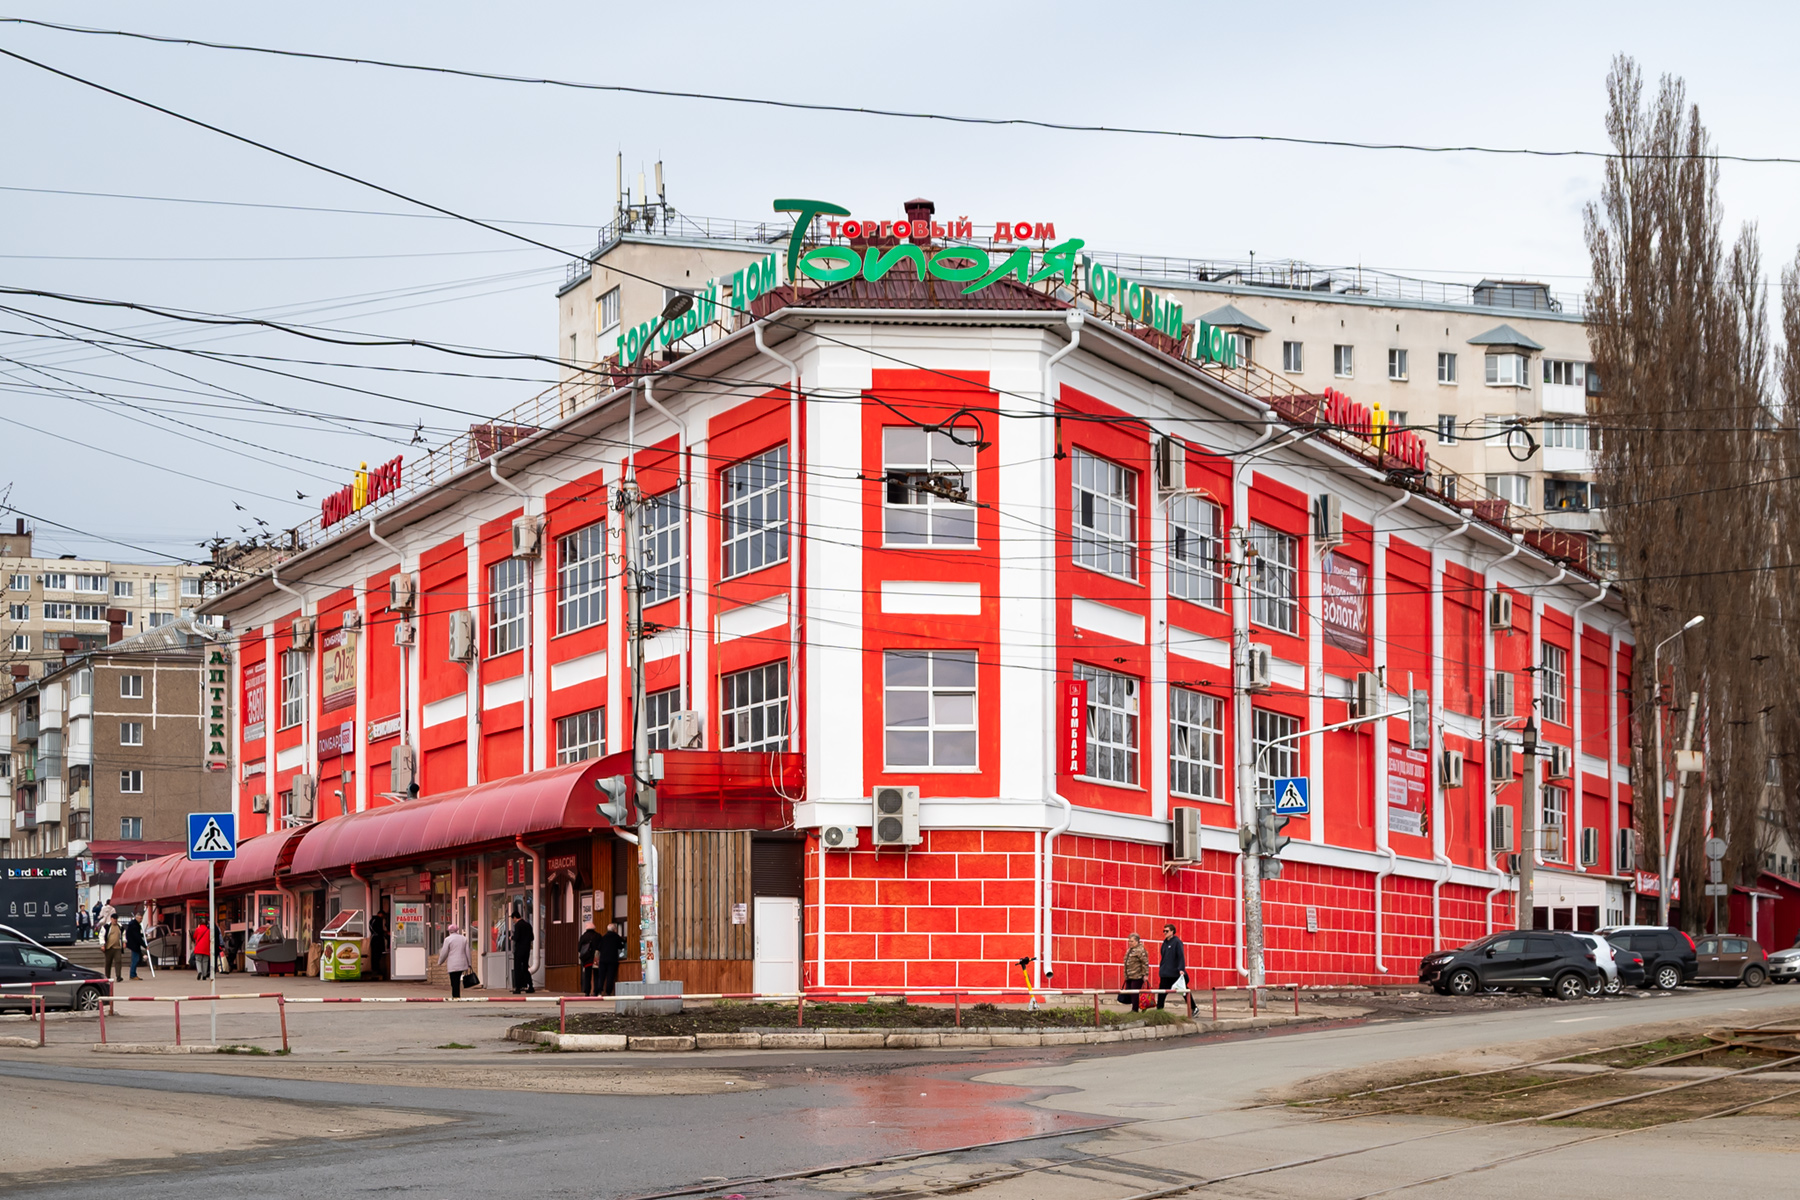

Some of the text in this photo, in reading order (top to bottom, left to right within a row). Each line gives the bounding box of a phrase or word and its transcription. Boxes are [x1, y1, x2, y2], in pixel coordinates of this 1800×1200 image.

[772, 198, 1085, 295] Тополя
[827, 216, 1056, 244] ТОРГОВЫЙ ДОМ
[617, 251, 778, 368] ТОРГОВЫЙ ДОМ
[1080, 254, 1237, 370] ТОРГОВЫЙ ДОМ
[1323, 582, 1357, 606] РАСПРОДАЖА
[1323, 600, 1360, 632] ЗОЛОТА
[209, 651, 226, 756] АПТЕКА
[318, 733, 342, 753] ЛОМБАРД
[1069, 697, 1079, 772] ЛОМБАРД
[547, 855, 576, 870] TABACCHI
